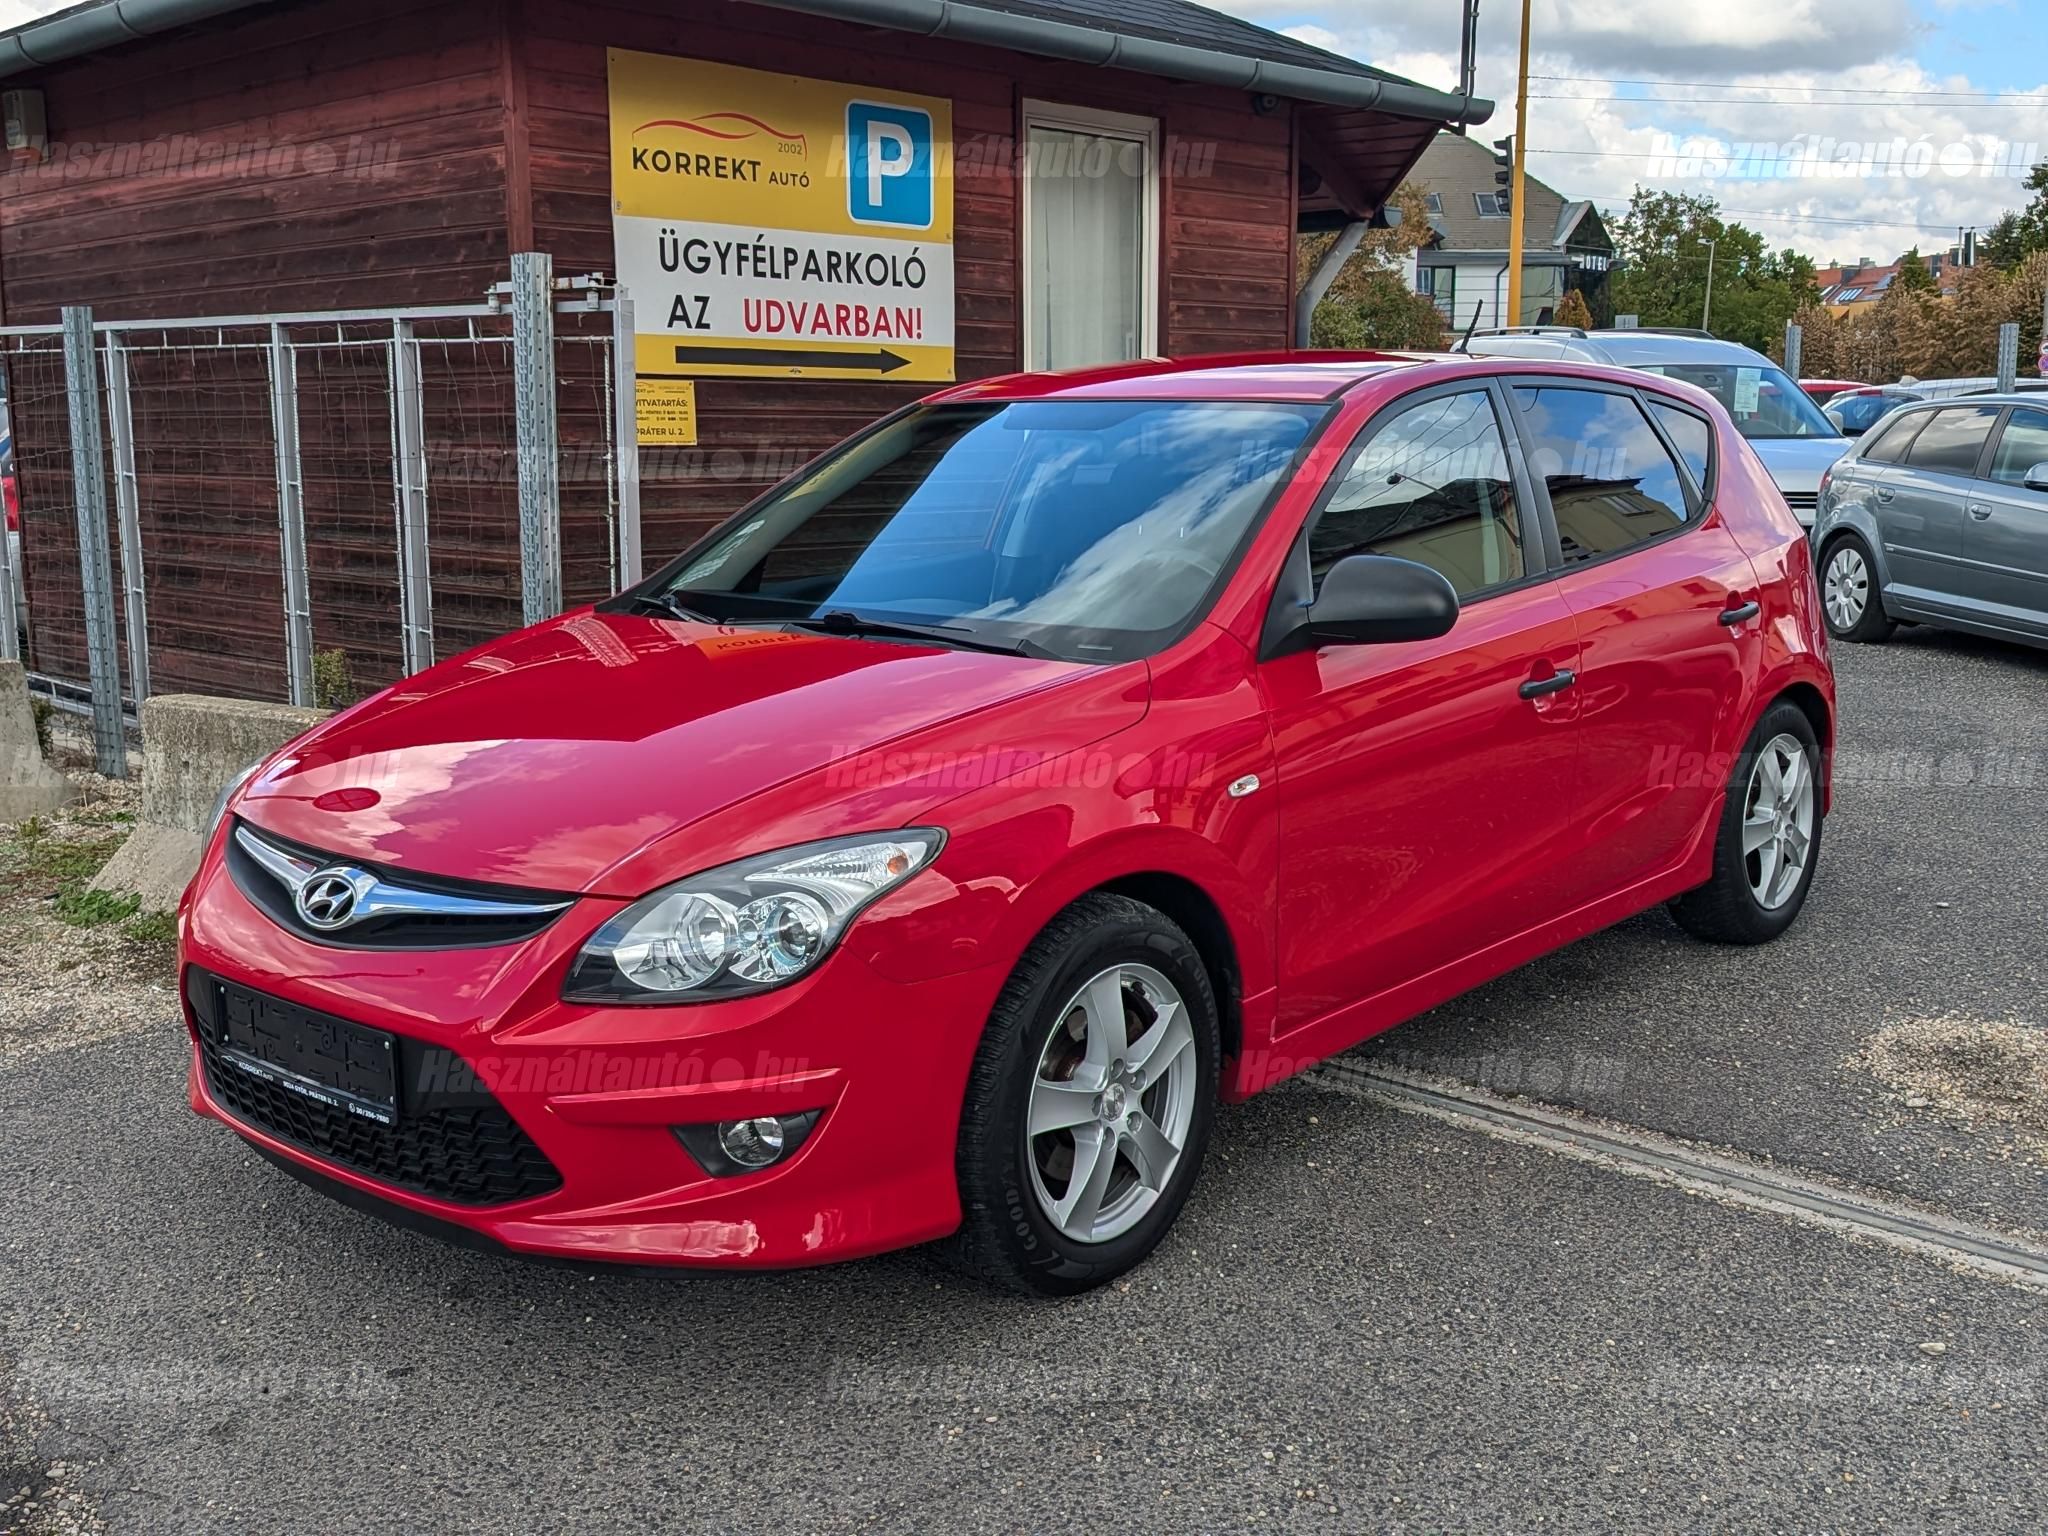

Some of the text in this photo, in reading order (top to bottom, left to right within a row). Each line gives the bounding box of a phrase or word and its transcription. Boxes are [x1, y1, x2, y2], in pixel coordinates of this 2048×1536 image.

[632, 147, 810, 188] KORREKT AUTÓ
[777, 142, 803, 155] 2002
[867, 120, 914, 207] P
[658, 228, 926, 289] ÜGYFÉLPARKOLÓ
[667, 294, 923, 340] AZ UDVARBAN!
[635, 398, 689, 408] YITVATARTÁS:
